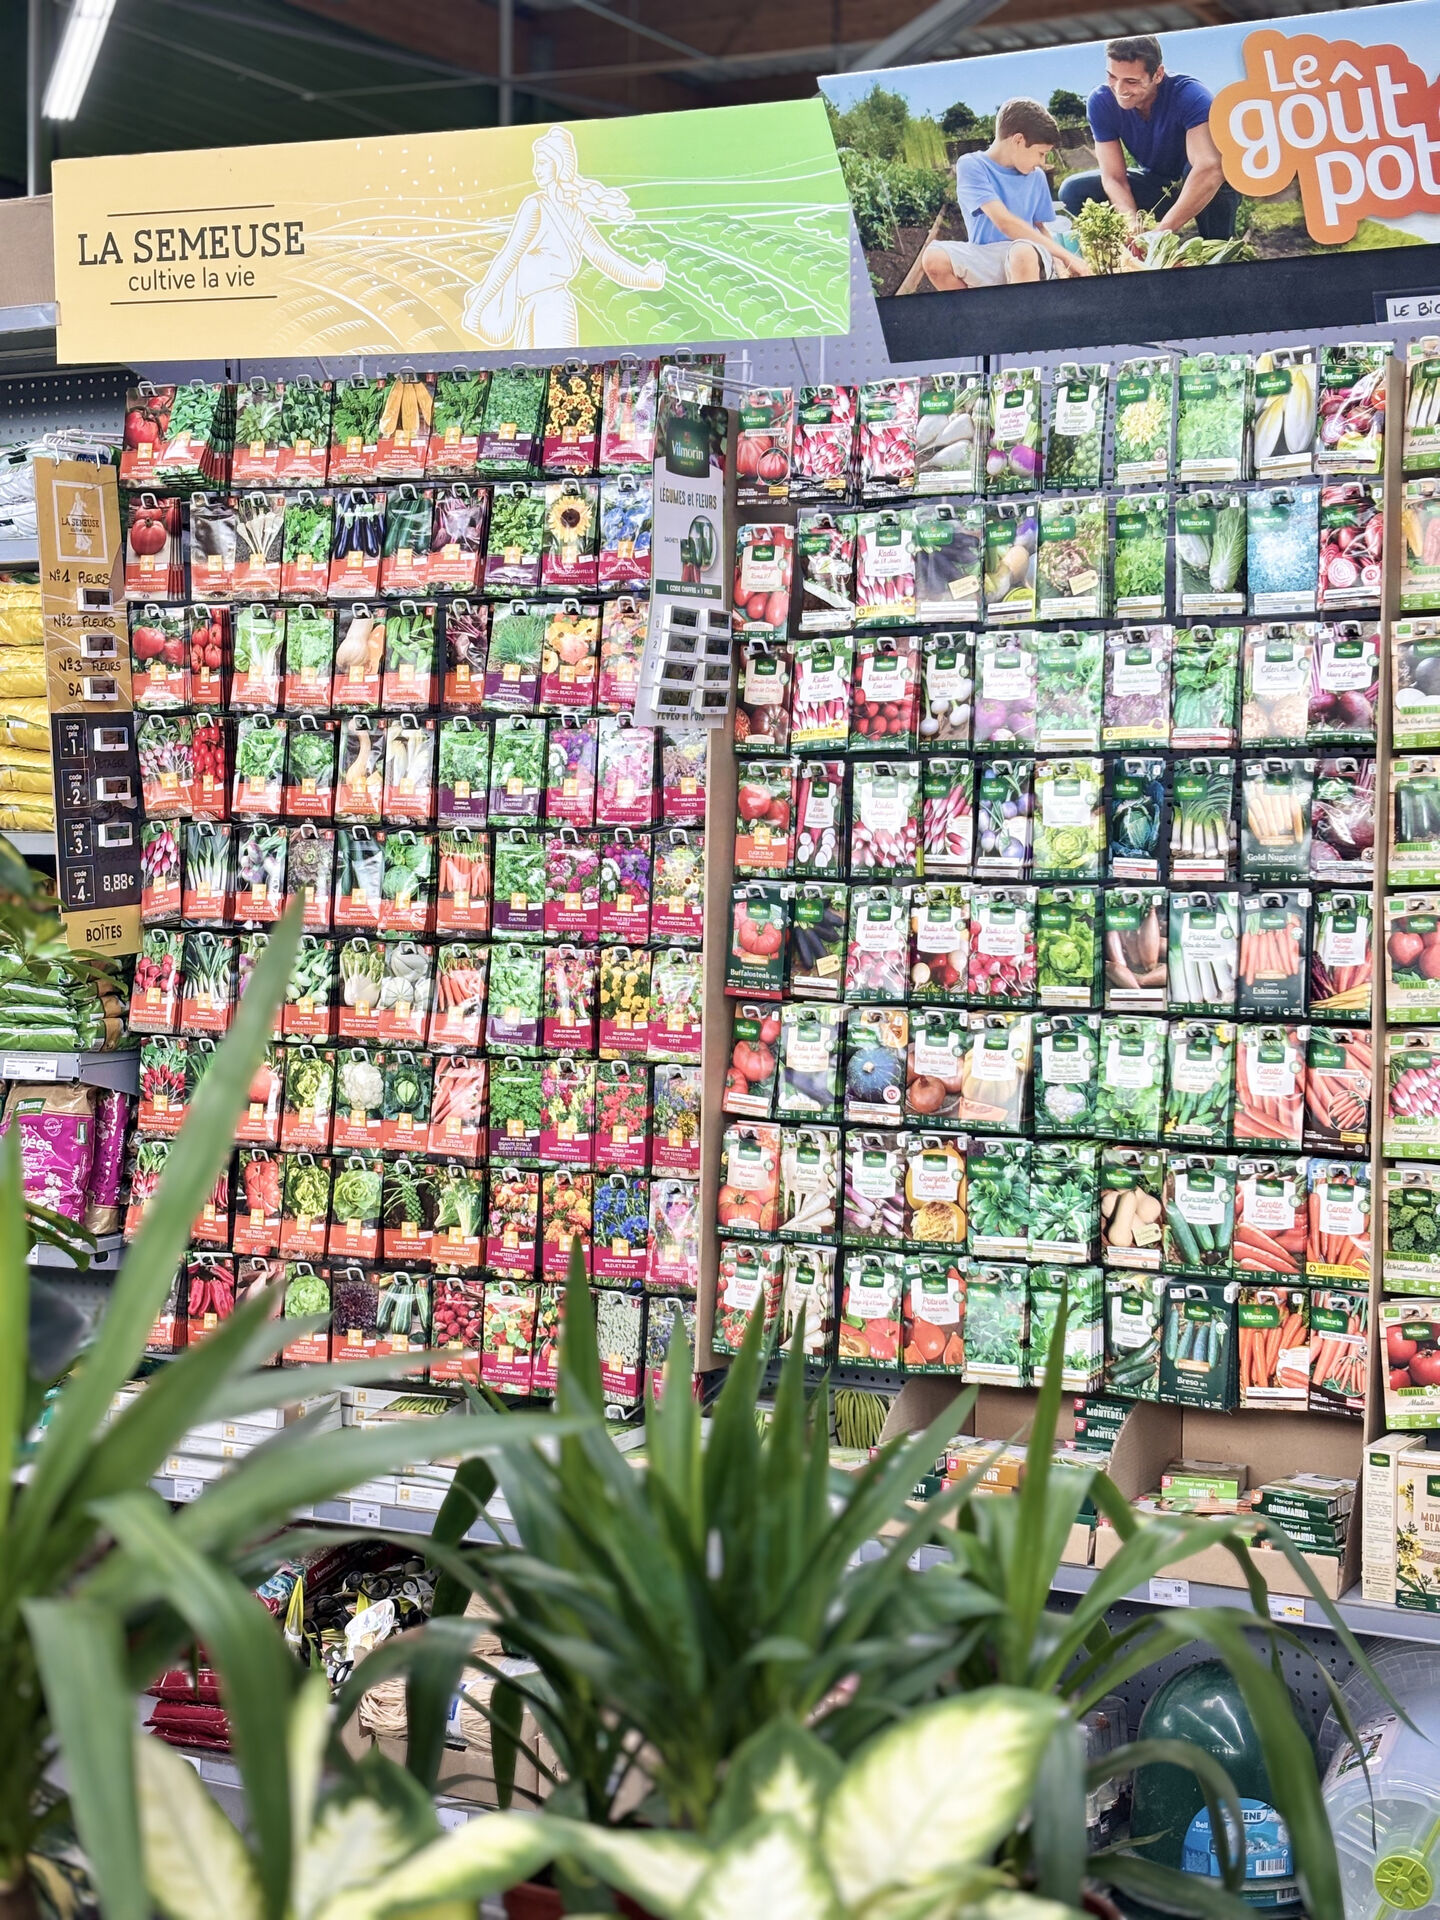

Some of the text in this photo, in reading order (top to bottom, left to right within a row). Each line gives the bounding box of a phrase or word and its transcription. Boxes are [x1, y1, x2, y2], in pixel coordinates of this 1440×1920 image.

[1264, 50, 1321, 92] Le
[1229, 60, 1414, 179] goût
[79, 221, 305, 266] LA SEMEUSE
[129, 265, 255, 293] cultive la vie
[1394, 304, 1410, 318] LE
[1325, 373, 1353, 381] Vilmorin
[1183, 383, 1211, 391] Vilmorin
[1259, 381, 1286, 389] Vilmorin
[1119, 388, 1145, 396] Vilmorin
[922, 400, 949, 409] Vilmorin
[672, 440, 704, 461] Vilmorin
[660, 482, 717, 510] LÉGUMES et FLEURS
[71, 517, 100, 528] SEMEUSE
[1119, 522, 1142, 531] Vilmorin
[1180, 518, 1210, 527] Vilmorin
[1042, 525, 1070, 533] Vilmorin
[920, 531, 948, 539] Vilmorin
[989, 530, 1012, 538] Vilmorin
[82, 616, 116, 629] FLEURS
[92, 661, 121, 672] FLEURS
[66, 724, 79, 732] code
[1176, 785, 1203, 794] Vilmorin
[71, 822, 85, 830] code
[1267, 853, 1297, 862] Nugget
[74, 870, 87, 878] code
[86, 923, 122, 942] BOÎTES
[730, 969, 771, 979] Buffalosteak
[1253, 987, 1279, 995] Eskimo
[1313, 1053, 1341, 1061] Vilmorin
[971, 1164, 999, 1172] Vilmorin
[1407, 1194, 1428, 1202] Vilmorin
[1243, 1312, 1273, 1321] Vilmorin
[1316, 1315, 1343, 1327] Vilmorin
[1177, 1376, 1199, 1386] Breso
[1399, 1388, 1424, 1396] TOMATE
[1268, 1504, 1310, 1519] GOURMANDEL
